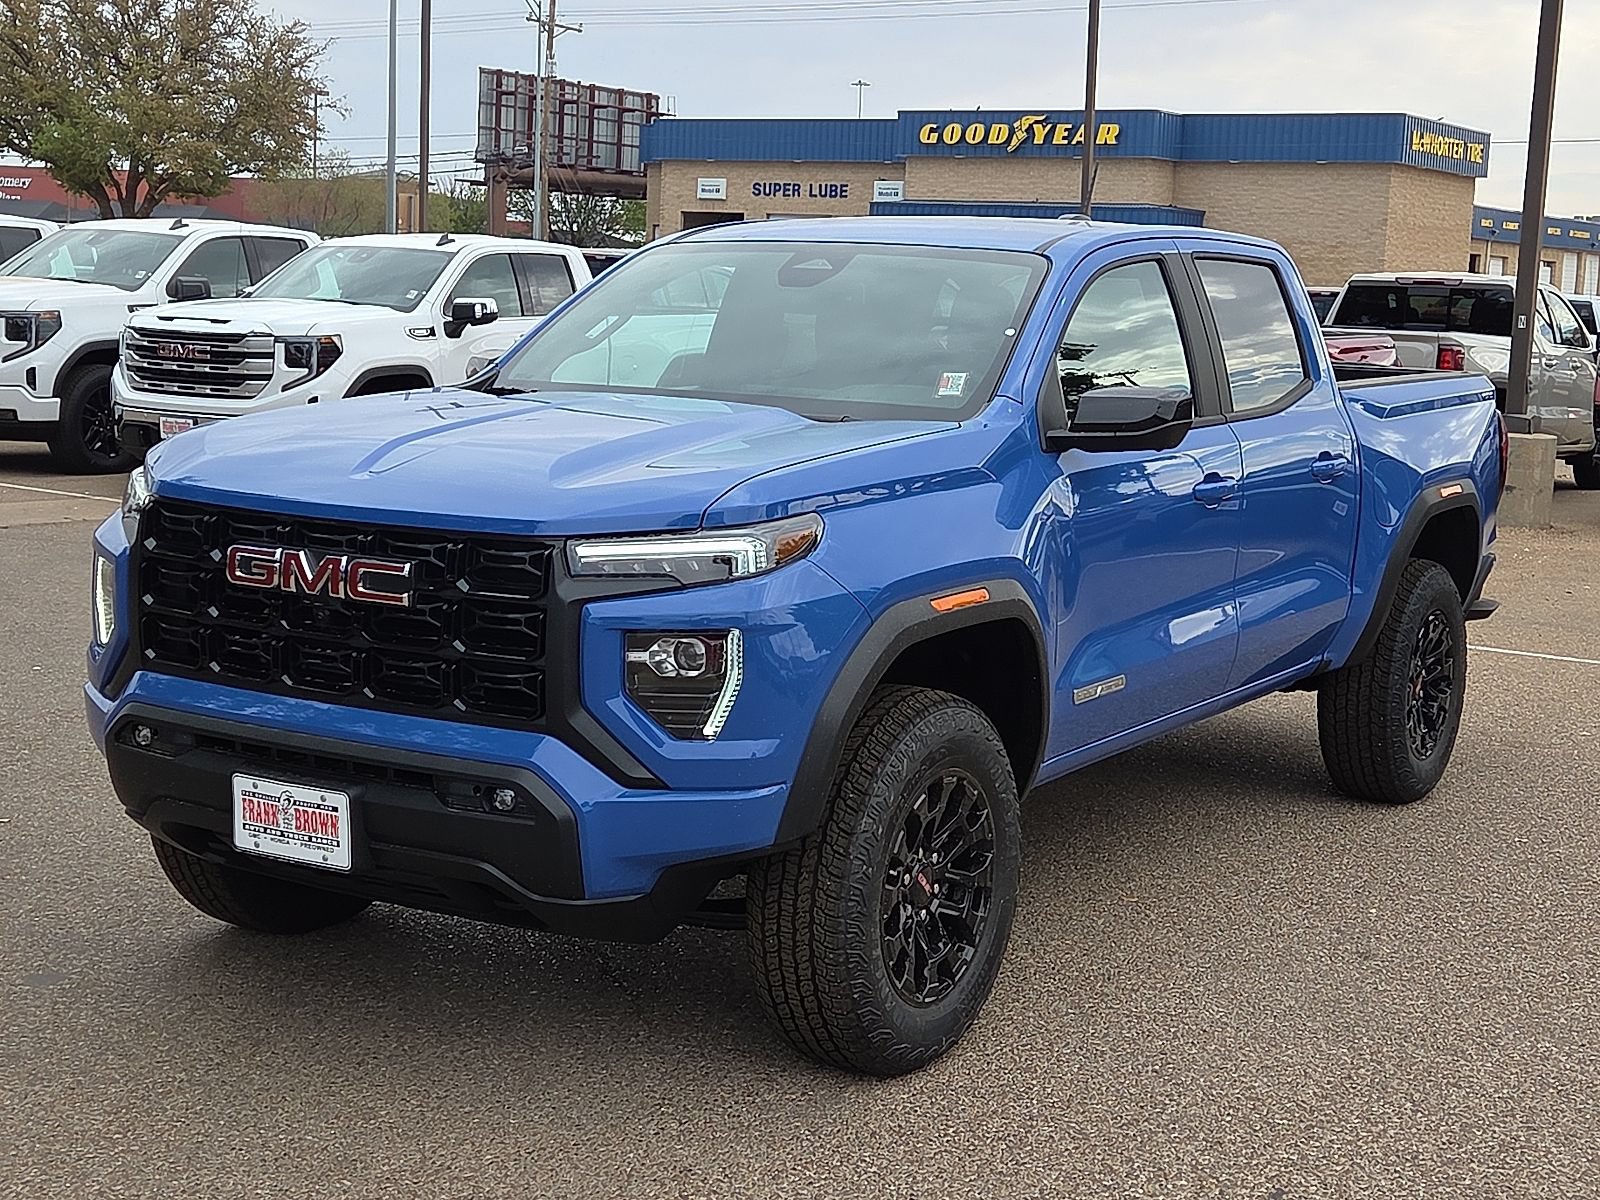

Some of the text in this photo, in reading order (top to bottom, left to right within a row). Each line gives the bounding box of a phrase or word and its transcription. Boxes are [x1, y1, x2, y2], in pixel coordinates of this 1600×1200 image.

[1467, 143, 1484, 164] TIRE
[752, 182, 849, 199] SUPER LUBE
[157, 343, 211, 359] GMC
[226, 544, 411, 607] GMC
[241, 797, 340, 839] FRANK BROWN
[244, 824, 338, 847] AUTO AND TRUCK RANCH
[270, 836, 291, 845] HONDA
